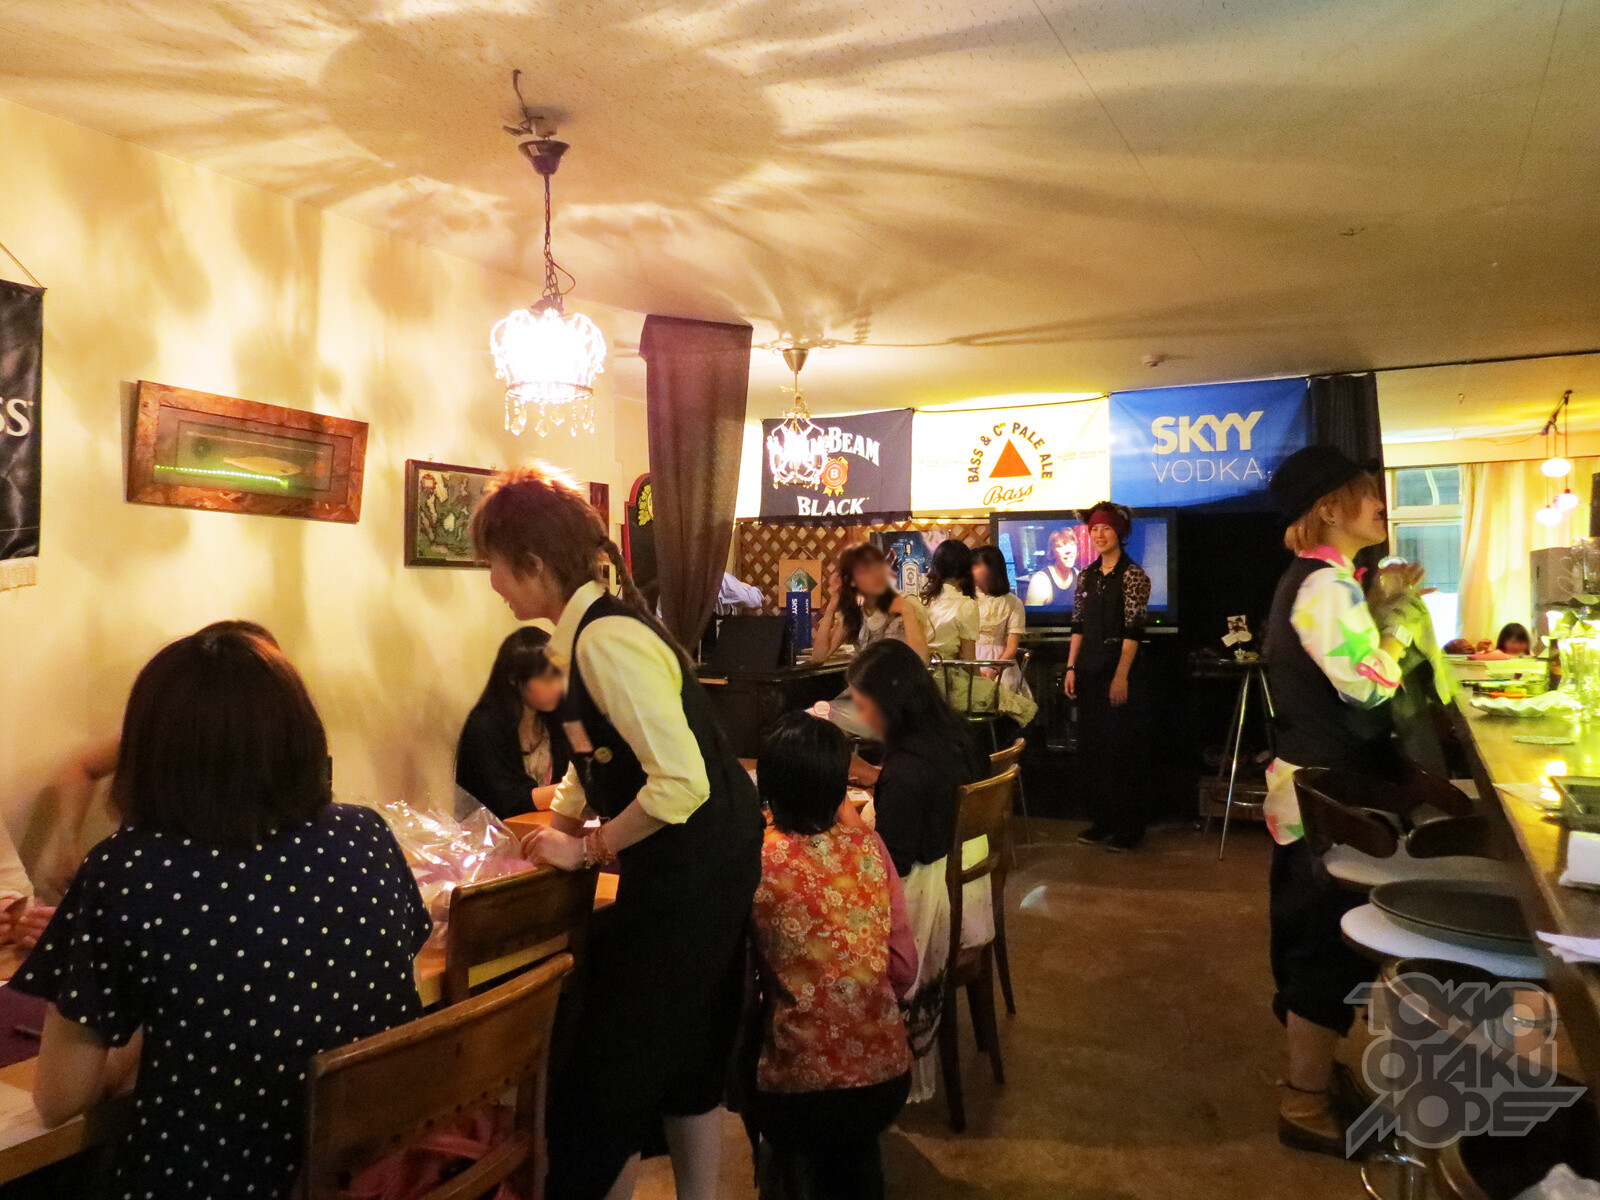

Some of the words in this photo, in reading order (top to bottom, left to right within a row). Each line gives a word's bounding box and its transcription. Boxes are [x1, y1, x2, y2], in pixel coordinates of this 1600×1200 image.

[0, 396, 30, 437] S
[1151, 410, 1265, 455] SKYY
[826, 426, 881, 468] BEAM
[967, 447, 984, 483] BASS
[980, 435, 992, 446] &
[1011, 421, 1046, 450] PALE
[1038, 453, 1054, 479] ALE
[1151, 457, 1265, 483] VODKA
[796, 495, 866, 517] BLACK
[982, 484, 1034, 506] Bass
